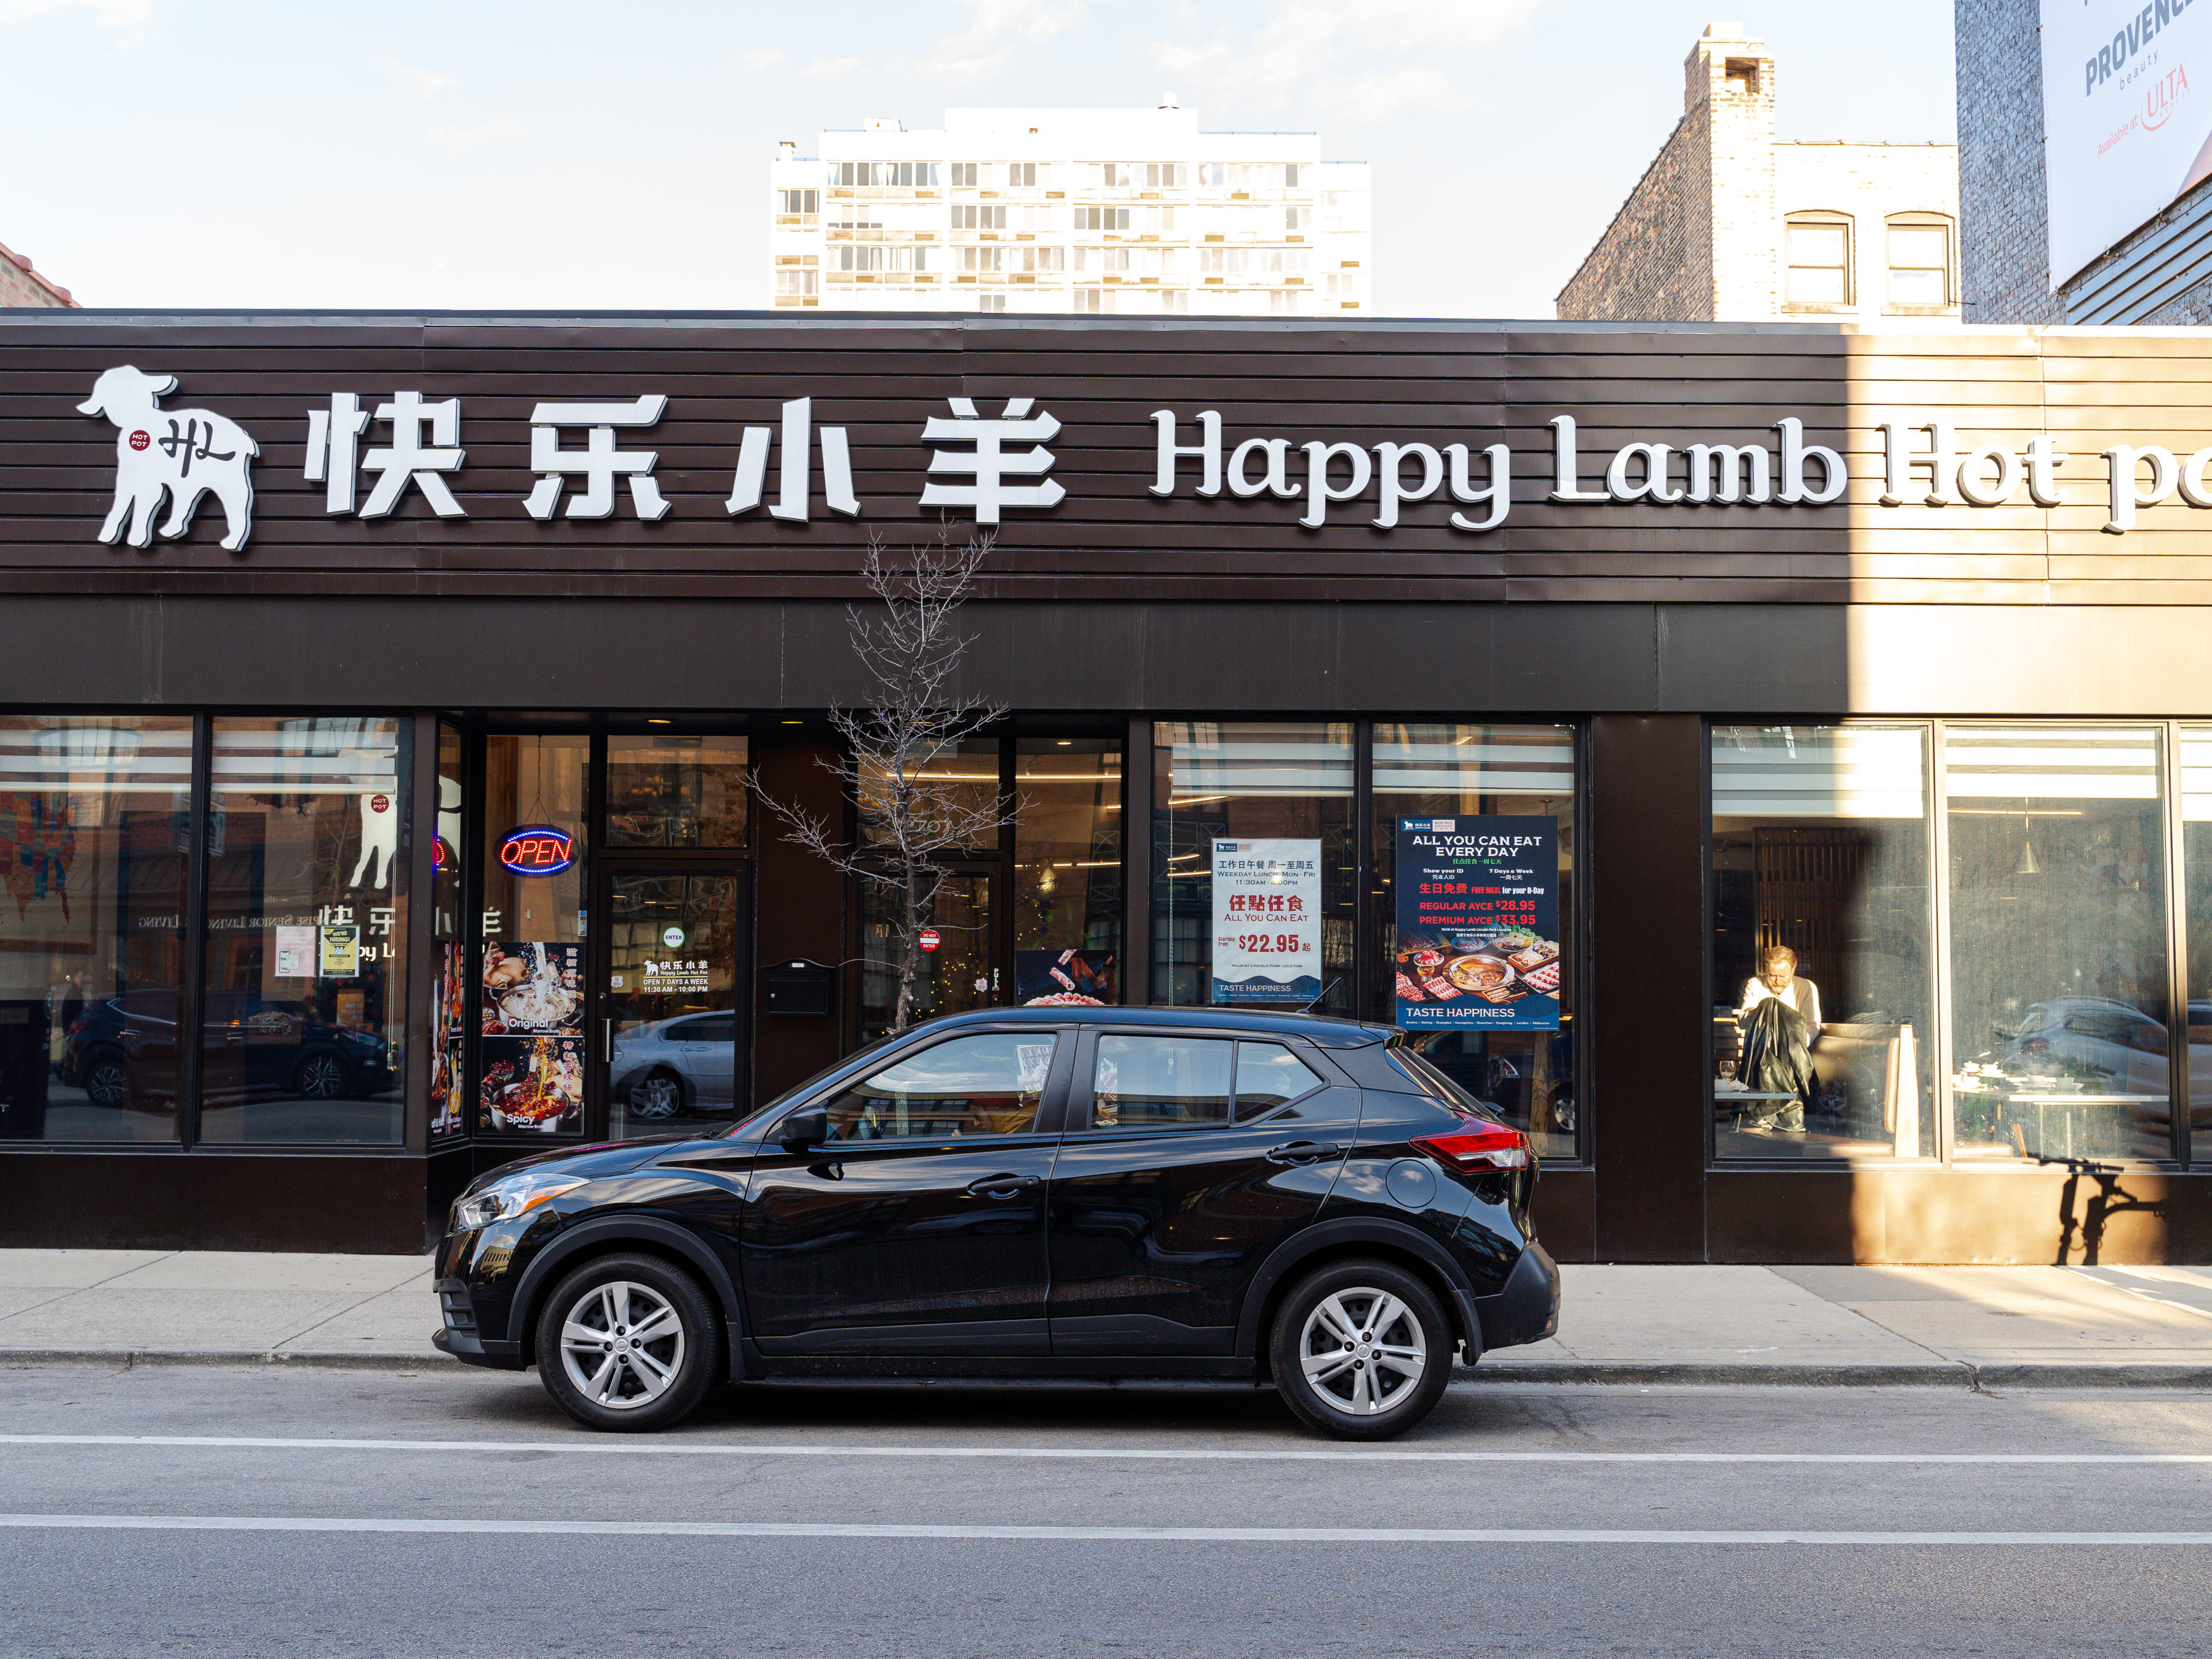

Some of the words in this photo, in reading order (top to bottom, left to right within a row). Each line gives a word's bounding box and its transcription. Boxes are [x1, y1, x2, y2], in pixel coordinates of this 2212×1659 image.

[2086, 0, 2194, 97] PROVEN
[2120, 49, 2158, 90] beauty
[2097, 124, 2128, 158] Available
[2130, 113, 2138, 130] at
[2147, 63, 2188, 117] ULTA
[303, 391, 1067, 525] 快乐小羊
[1148, 409, 1510, 532] Happy
[1548, 415, 1848, 505] Lamb
[1877, 421, 2071, 508] Hot
[1412, 836, 1441, 845] ALL
[1444, 836, 1475, 846] YOU
[1478, 836, 1510, 846] CAN
[1514, 836, 1542, 846] EAT
[501, 838, 573, 864] OPEN
[1435, 847, 1484, 857] EVERY
[1487, 847, 1519, 857] DAY
[1218, 860, 1265, 869] 工作日午餐
[1268, 861, 1314, 869] 周一至周五
[1419, 883, 1467, 893] 生日免费
[1527, 887, 1544, 895] B-Day
[1229, 895, 1303, 911] 任點任食
[1419, 902, 1466, 910] REGULAR
[1495, 900, 1535, 911] $28.95
[1245, 914, 1263, 922] YOU
[1495, 914, 1536, 925] $33.95
[1239, 934, 1299, 952] $22.95
[1302, 943, 1311, 952] 起
[660, 960, 708, 970] 快乐小羊
[1406, 1008, 1444, 1017] TASTE
[1446, 1008, 1515, 1017] HAPPINESS
[509, 1018, 548, 1029] Original
[507, 1113, 535, 1124] Spicy
